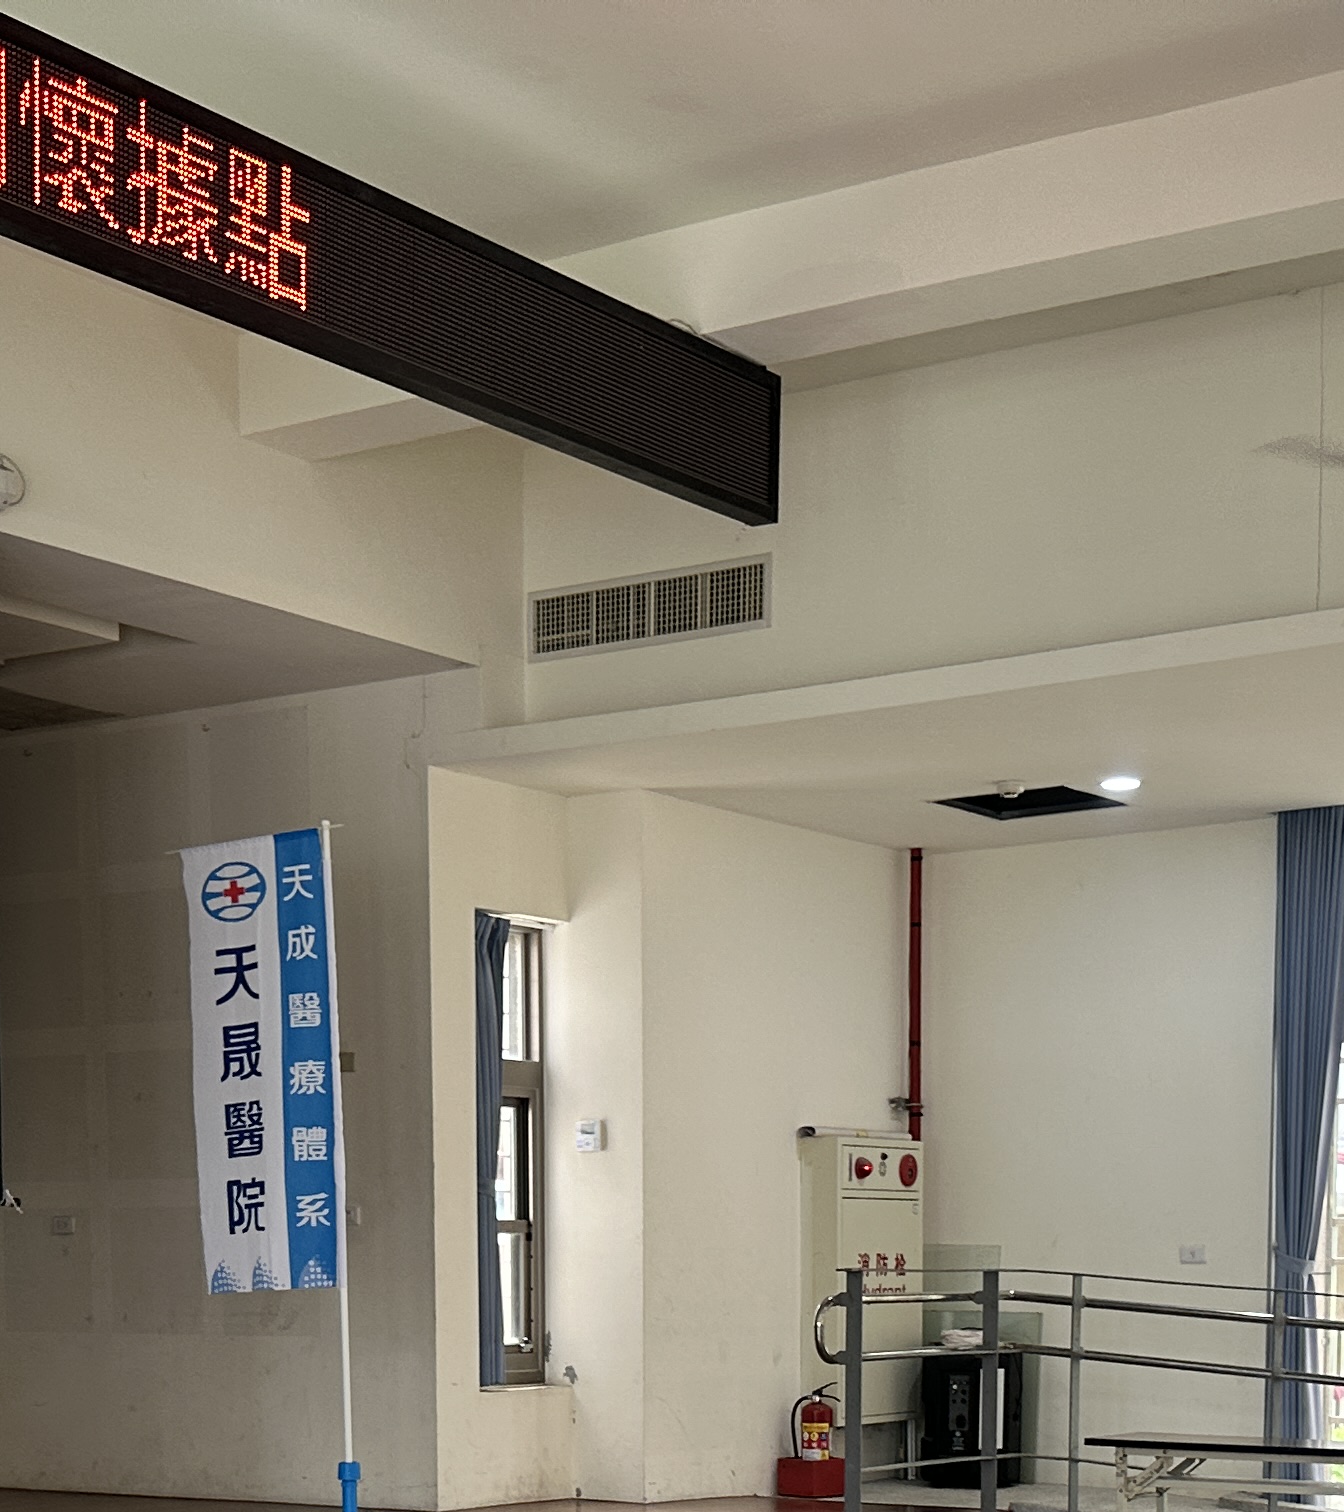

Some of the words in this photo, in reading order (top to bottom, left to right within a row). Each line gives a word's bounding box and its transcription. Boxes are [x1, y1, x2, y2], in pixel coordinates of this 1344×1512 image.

[213, 944, 266, 1235] 天晟醫院
[282, 863, 331, 1228] 天成醫療體系
